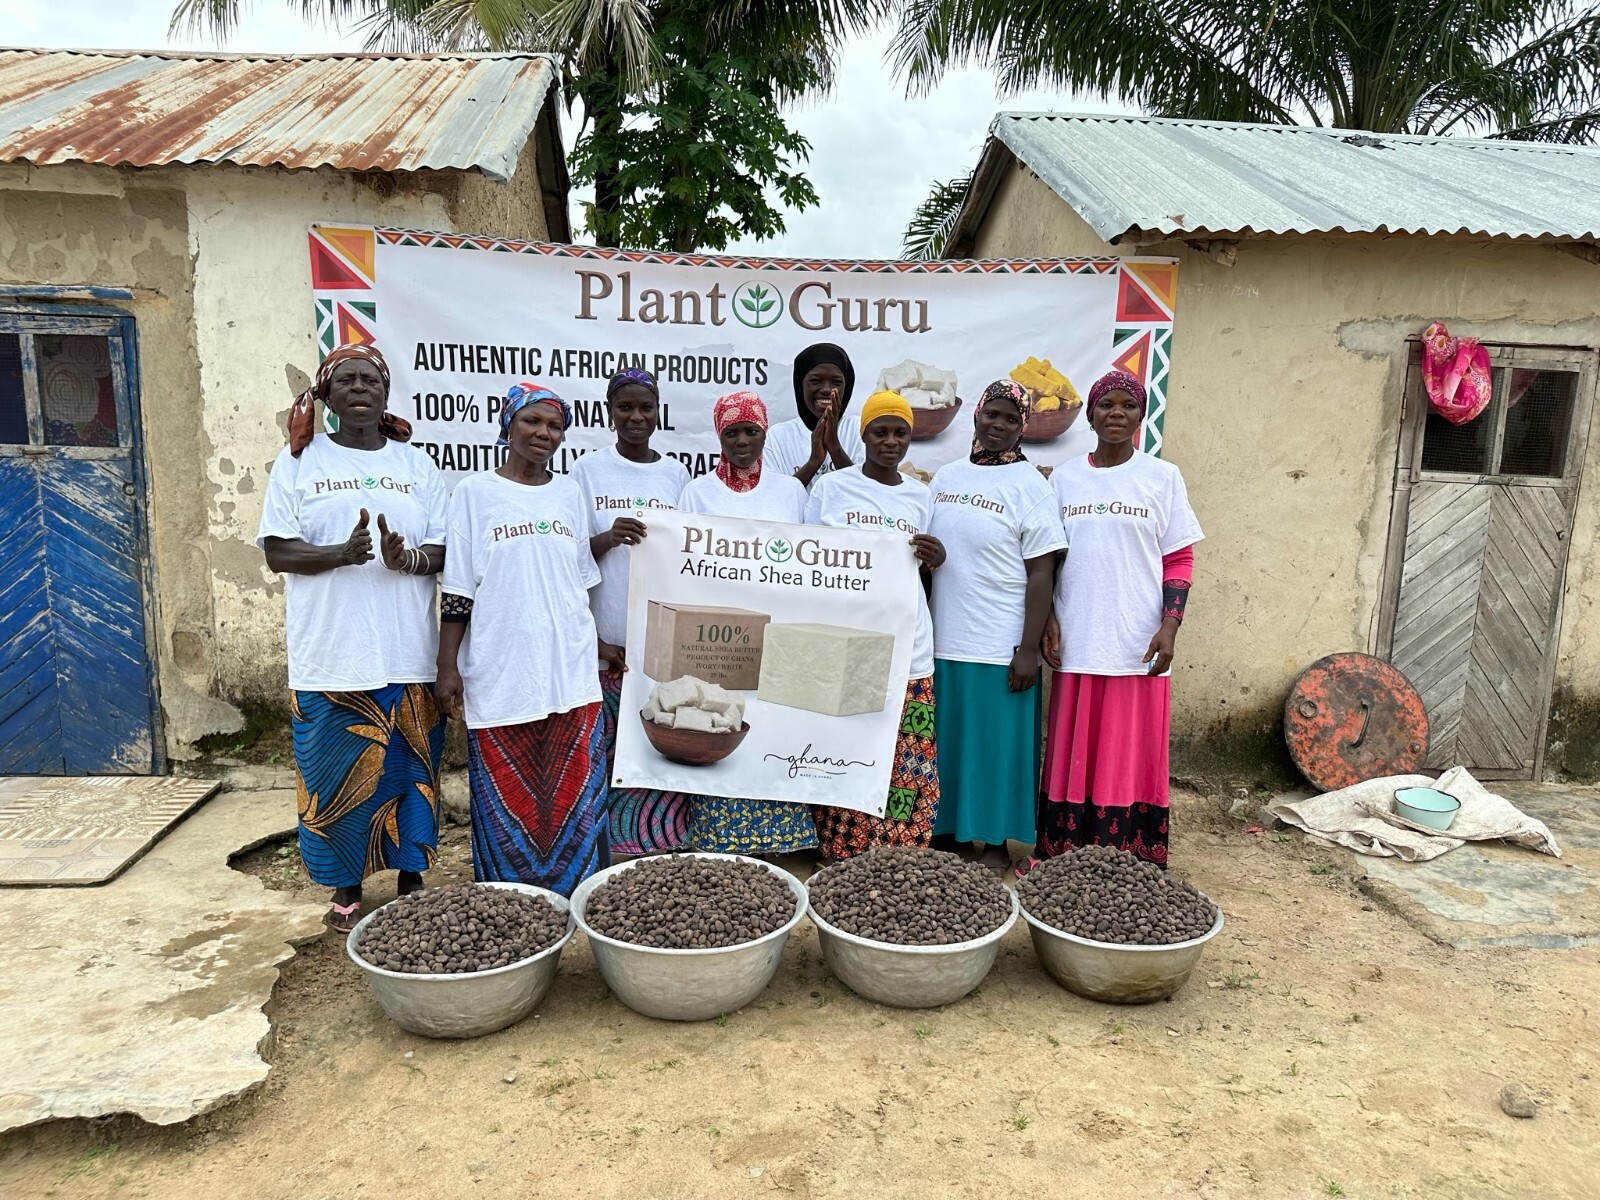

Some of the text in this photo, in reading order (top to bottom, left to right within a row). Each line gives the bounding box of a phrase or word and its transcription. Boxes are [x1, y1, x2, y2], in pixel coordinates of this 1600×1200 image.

[575, 270, 932, 333] Plant Guru
[414, 342, 768, 386] AUTHENTIC AFRICAN PRODUCTS
[412, 392, 479, 423] 100%
[314, 478, 361, 494] Plant
[594, 495, 632, 511] Plant
[934, 491, 1005, 514] Plant Guru
[1061, 501, 1149, 520] Plant Guru
[846, 511, 883, 526] Plant
[492, 521, 535, 542] Plant
[680, 526, 873, 571] Plant Guru
[680, 558, 870, 591] African Shea Butter
[696, 624, 750, 645] 100%
[681, 644, 714, 652] NATURAL
[763, 743, 875, 778] ghana
